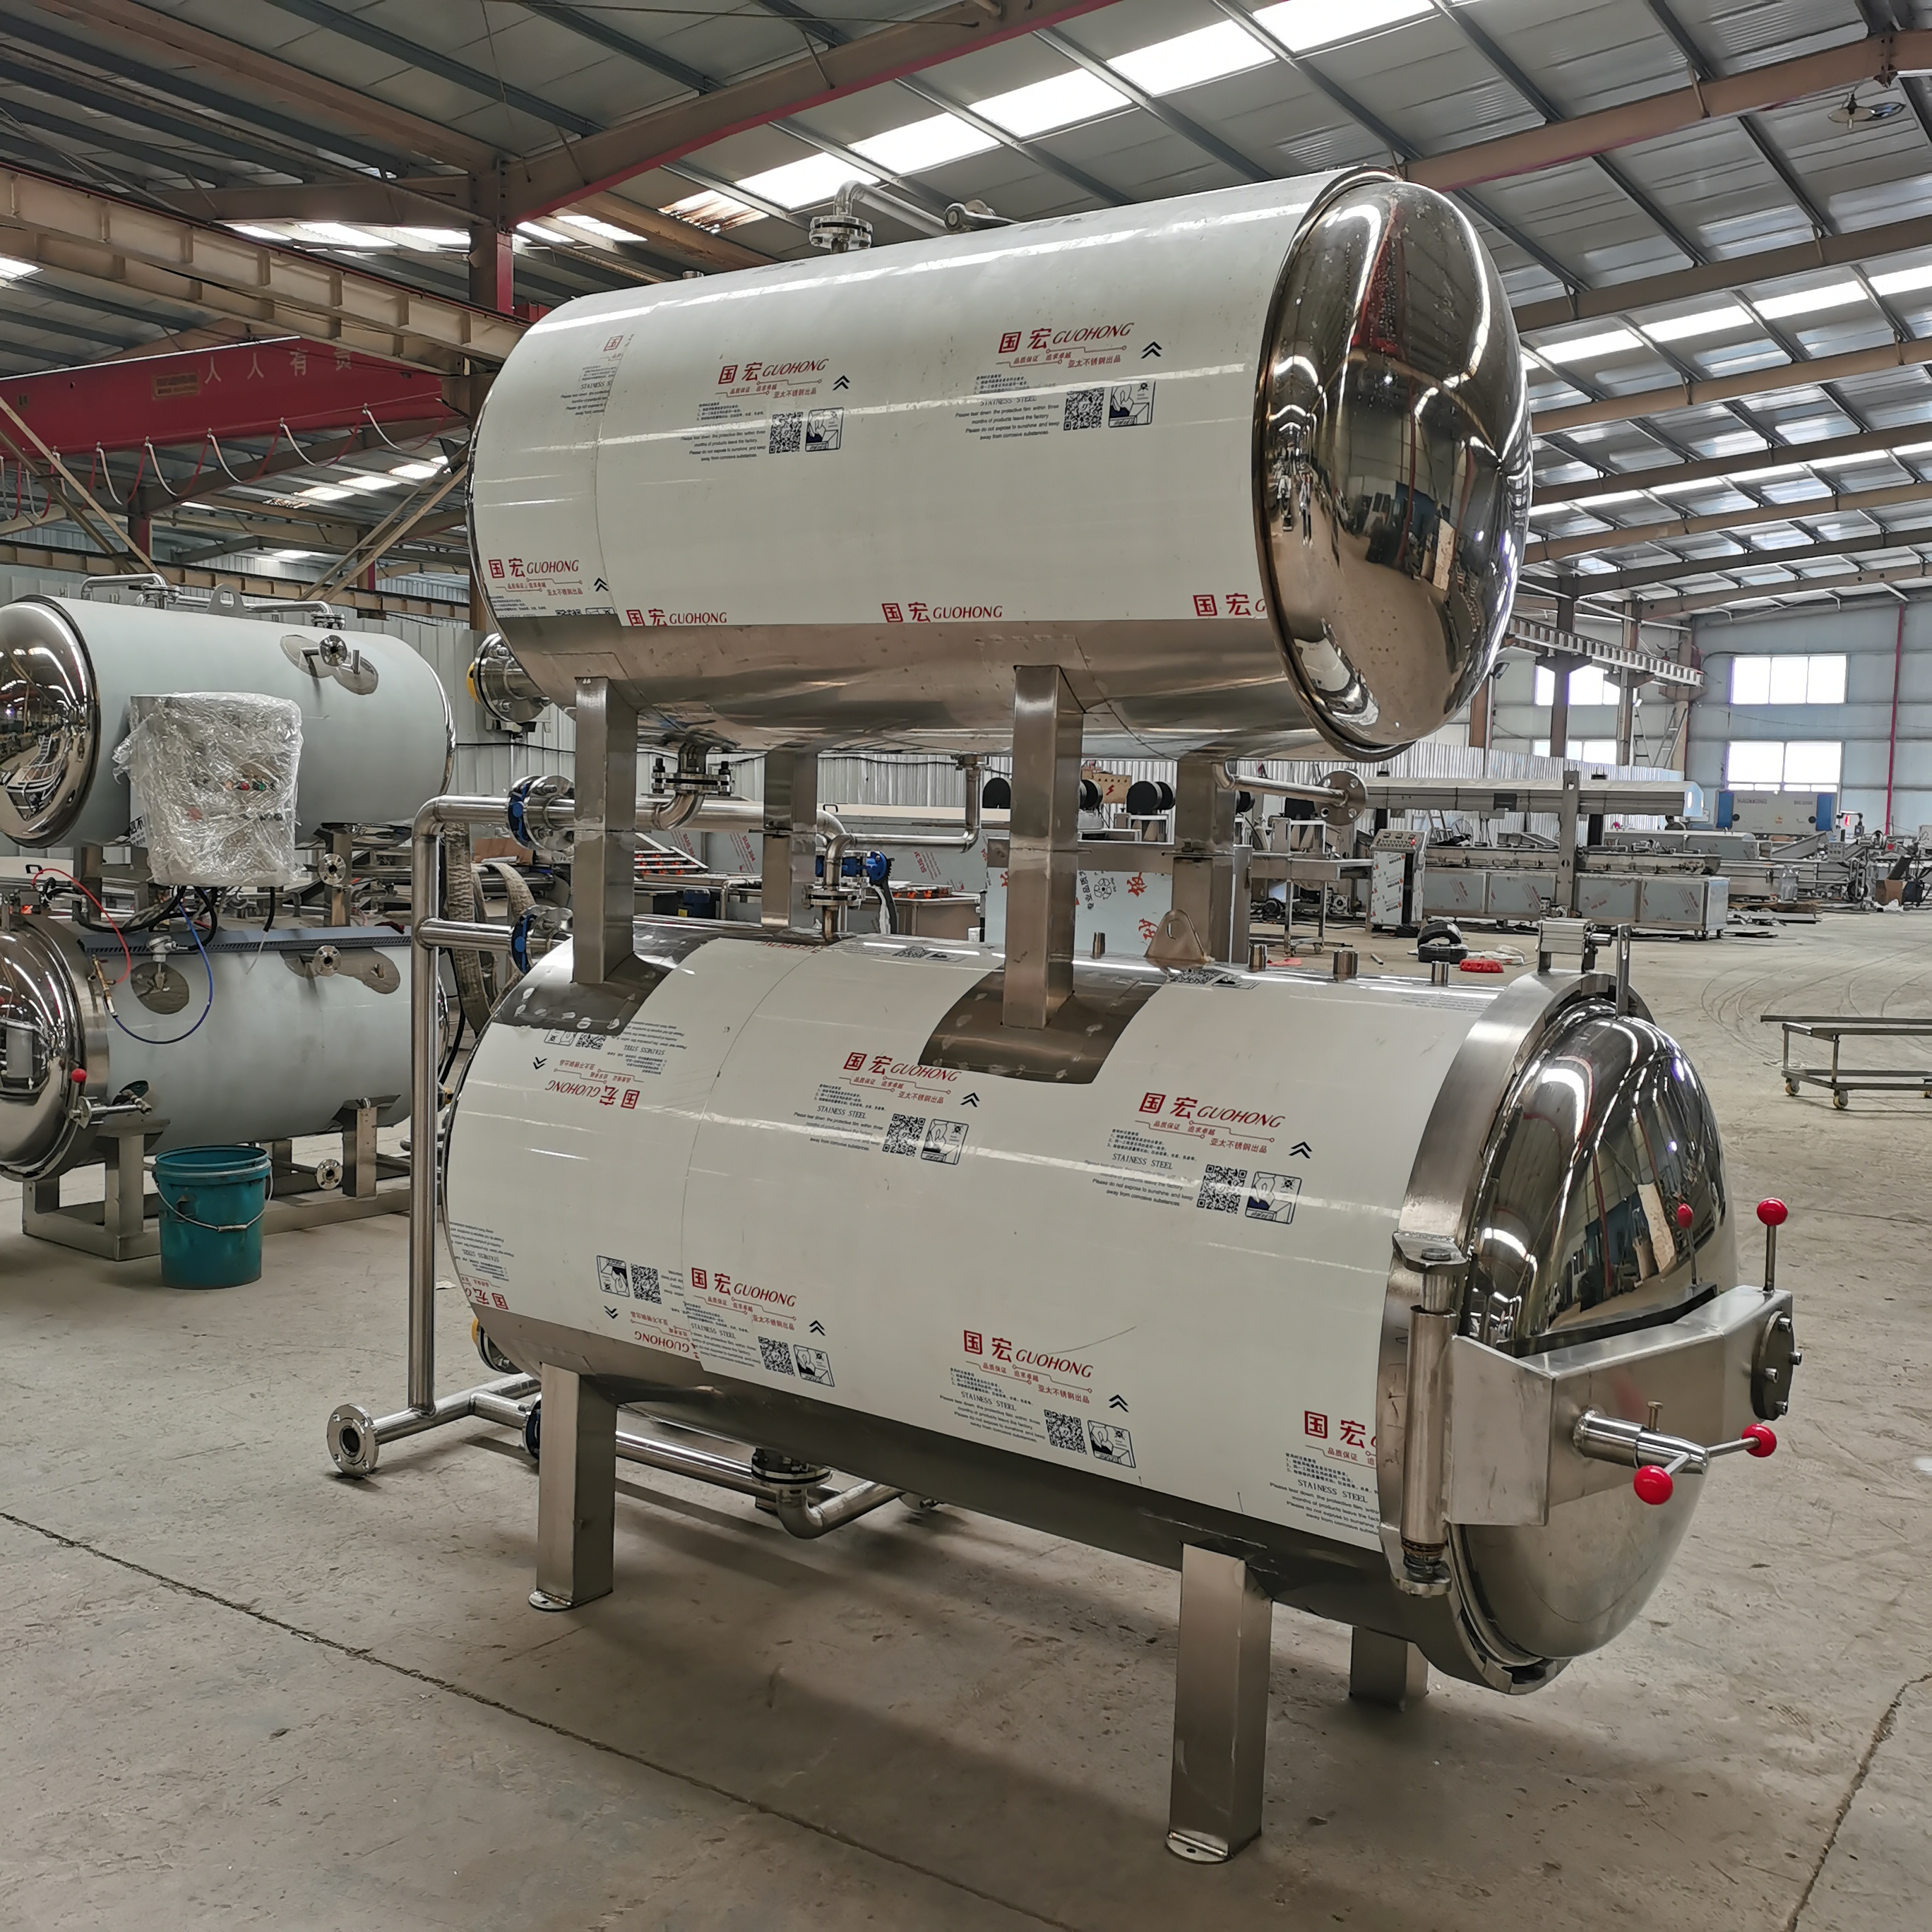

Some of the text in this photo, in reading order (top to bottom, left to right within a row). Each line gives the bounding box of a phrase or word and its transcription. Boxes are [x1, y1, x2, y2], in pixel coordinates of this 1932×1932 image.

[998, 323, 1134, 353] 国宏 GUOHONG
[718, 359, 829, 384] 国宏 GUOHONG
[489, 558, 579, 578] 国宏 GUOHONG
[881, 602, 1003, 623] 国宏 GUOHONG
[1193, 593, 1251, 616] 国宏
[669, 612, 727, 624] GUOHONG
[843, 1052, 962, 1081] 国宏 GUOHONG
[544, 1080, 601, 1097] GUOHONG
[817, 1106, 866, 1119] STAINESS STEEL
[1139, 1092, 1285, 1128] 国宏 GUOHONG
[1112, 1153, 1173, 1169] STAINESS STEEL
[691, 1267, 731, 1295] 国宏
[734, 1282, 797, 1307] GUOHONG
[634, 1330, 689, 1353] GUOHONG
[964, 1329, 1093, 1378] 国宏 GUOHONG
[961, 1390, 1017, 1411] STAINESS STEEL
[1304, 1410, 1366, 1448] 国宏
[1298, 1479, 1368, 1503] STAINESS STEEL
